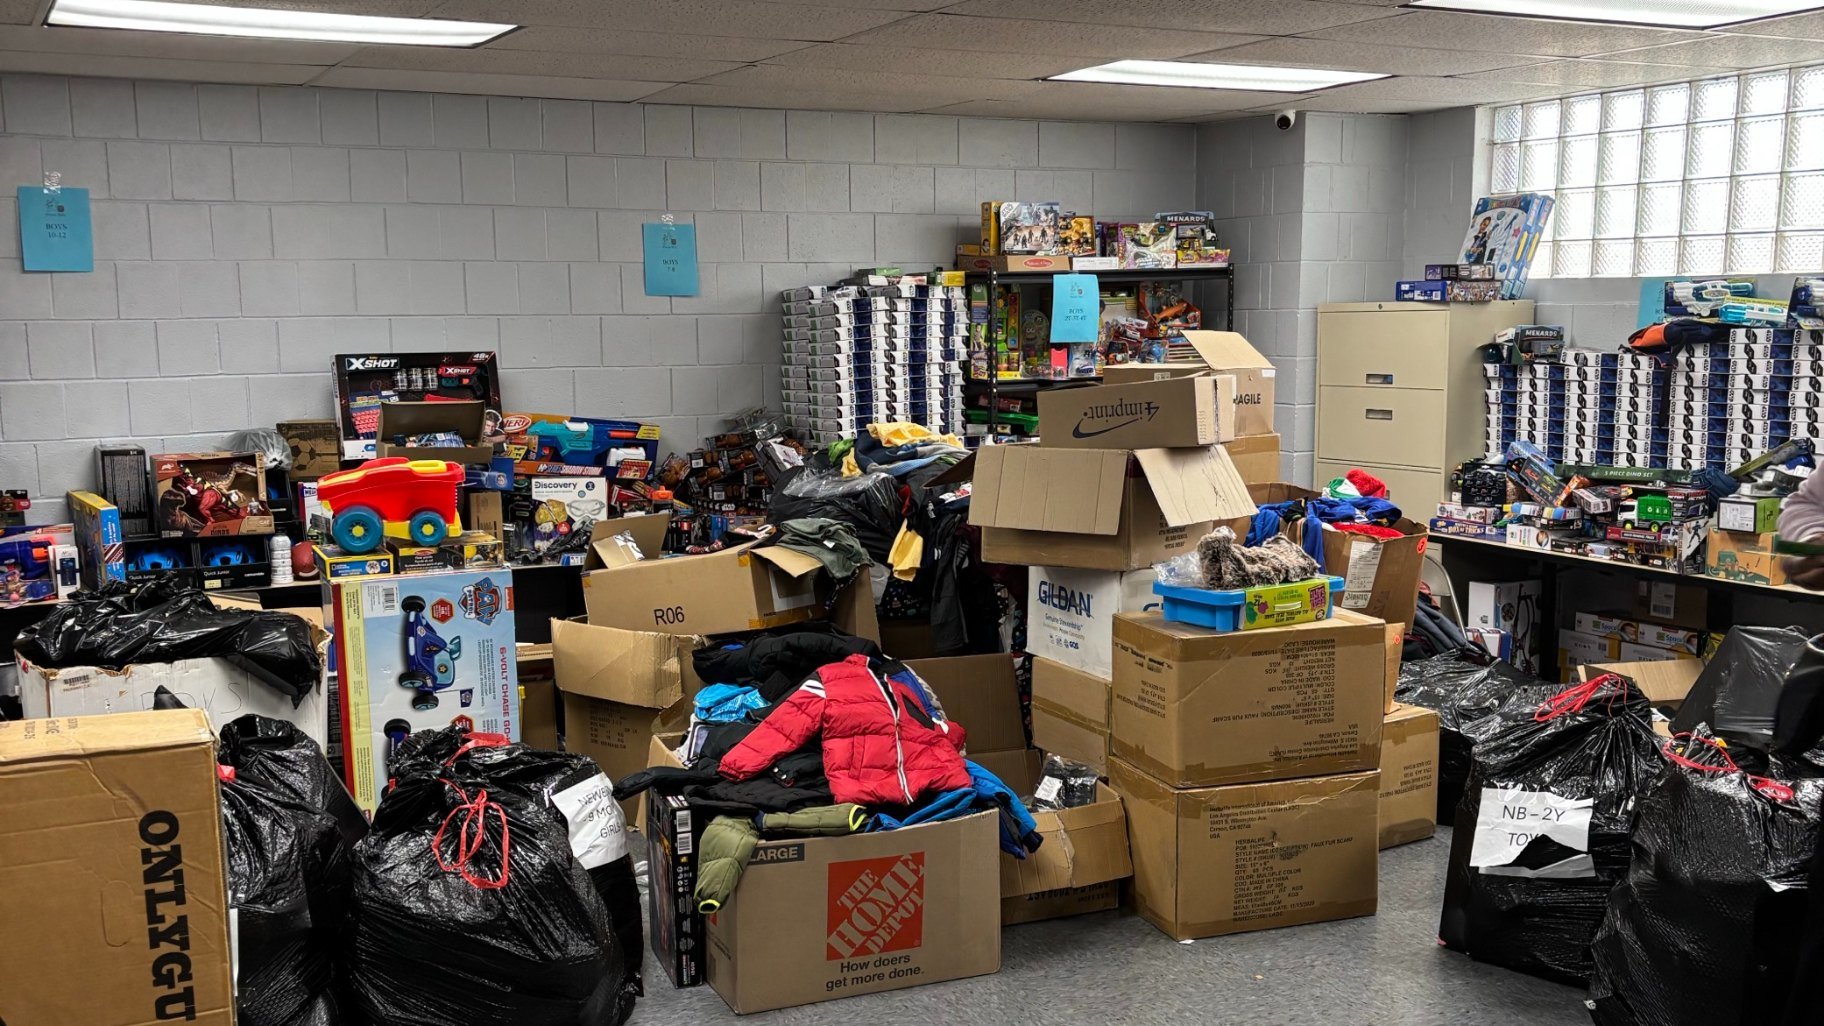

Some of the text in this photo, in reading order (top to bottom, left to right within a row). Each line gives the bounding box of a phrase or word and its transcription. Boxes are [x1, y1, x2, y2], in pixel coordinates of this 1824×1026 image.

[1233, 393, 1260, 404] RAGILE
[534, 481, 577, 490] Discovery
[1038, 580, 1091, 618] GILDAN
[654, 606, 685, 625] R06
[499, 646, 512, 742] 6-VOLT CHASE GO-
[600, 822, 620, 838] GIRLS
[750, 846, 798, 861] LARGE
[837, 869, 880, 910] THE
[139, 810, 197, 1020] ONLYGU
[827, 853, 925, 960] HOME
[864, 887, 925, 955] DEPOT
[840, 956, 910, 974] How doers
[826, 966, 925, 991] get more done.
